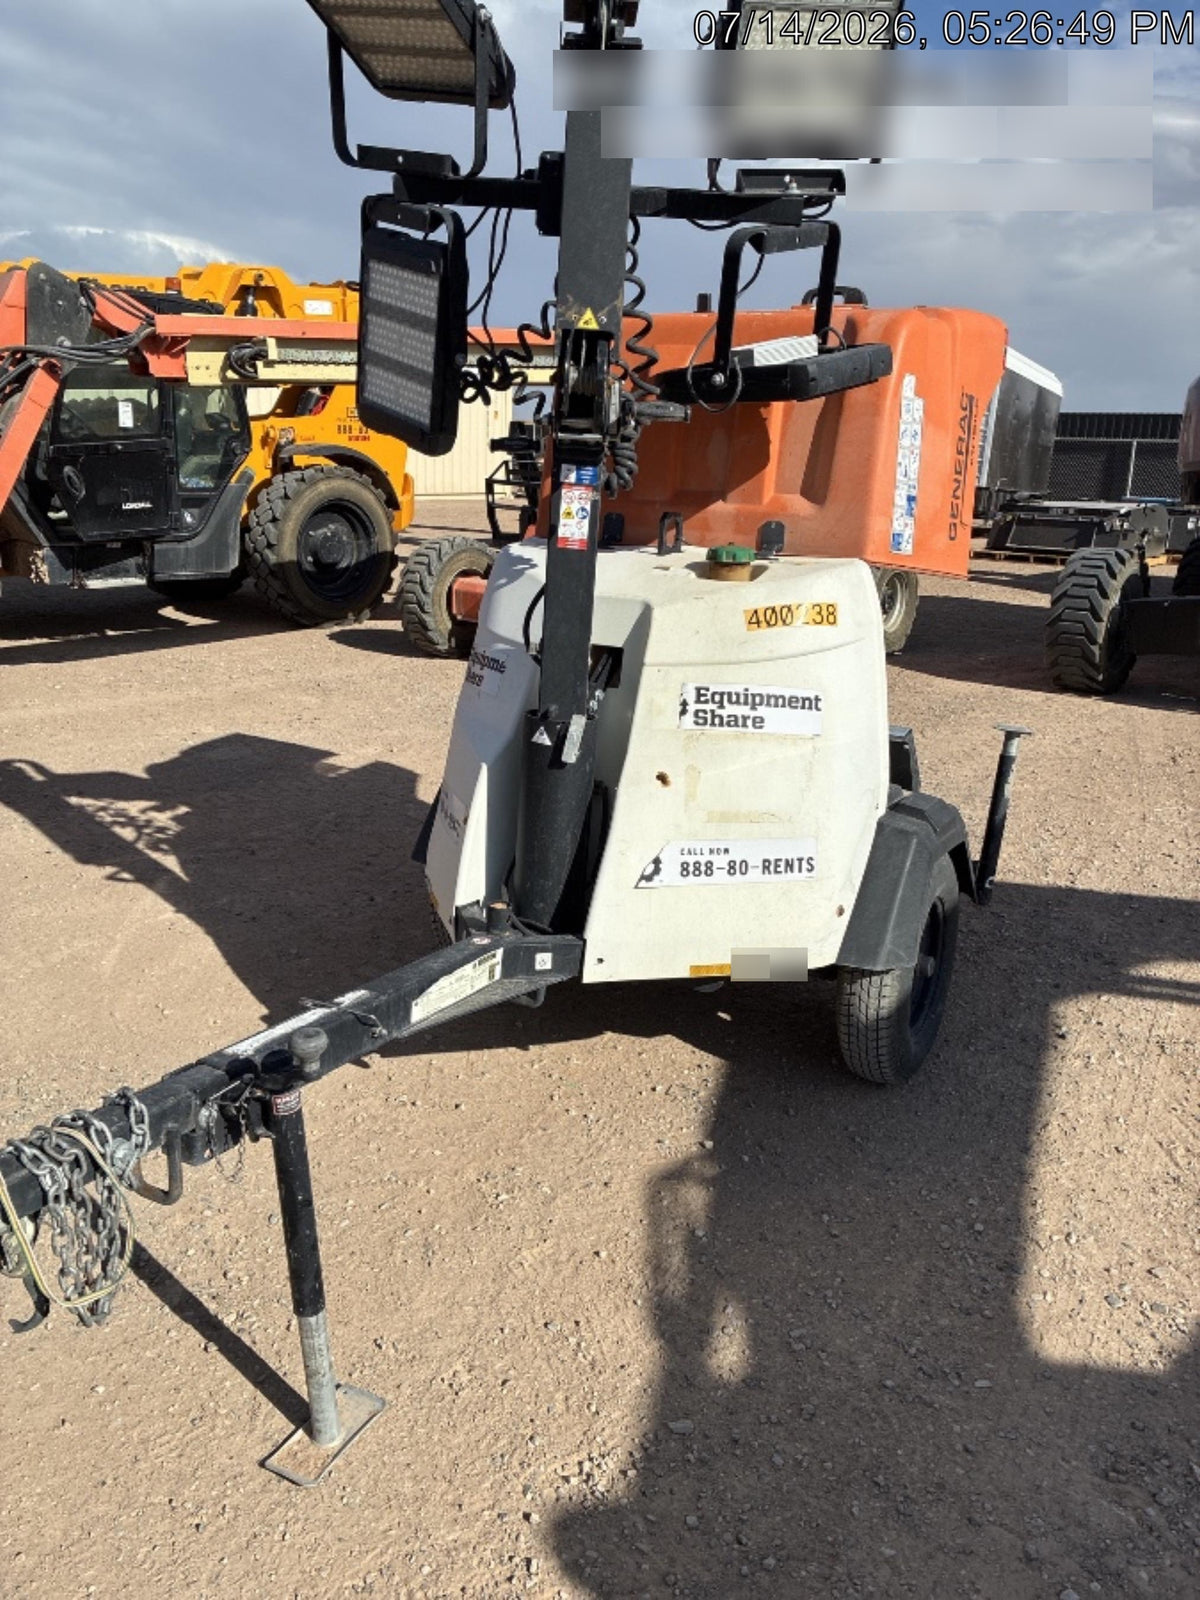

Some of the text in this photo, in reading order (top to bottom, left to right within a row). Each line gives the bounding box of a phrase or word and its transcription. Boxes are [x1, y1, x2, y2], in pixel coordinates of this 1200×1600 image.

[949, 384, 968, 541] GENERAC
[694, 686, 822, 712] Equipment
[693, 709, 765, 729] Share
[680, 847, 731, 856] CALL NOW
[679, 856, 816, 878] 888-80-RENTS
